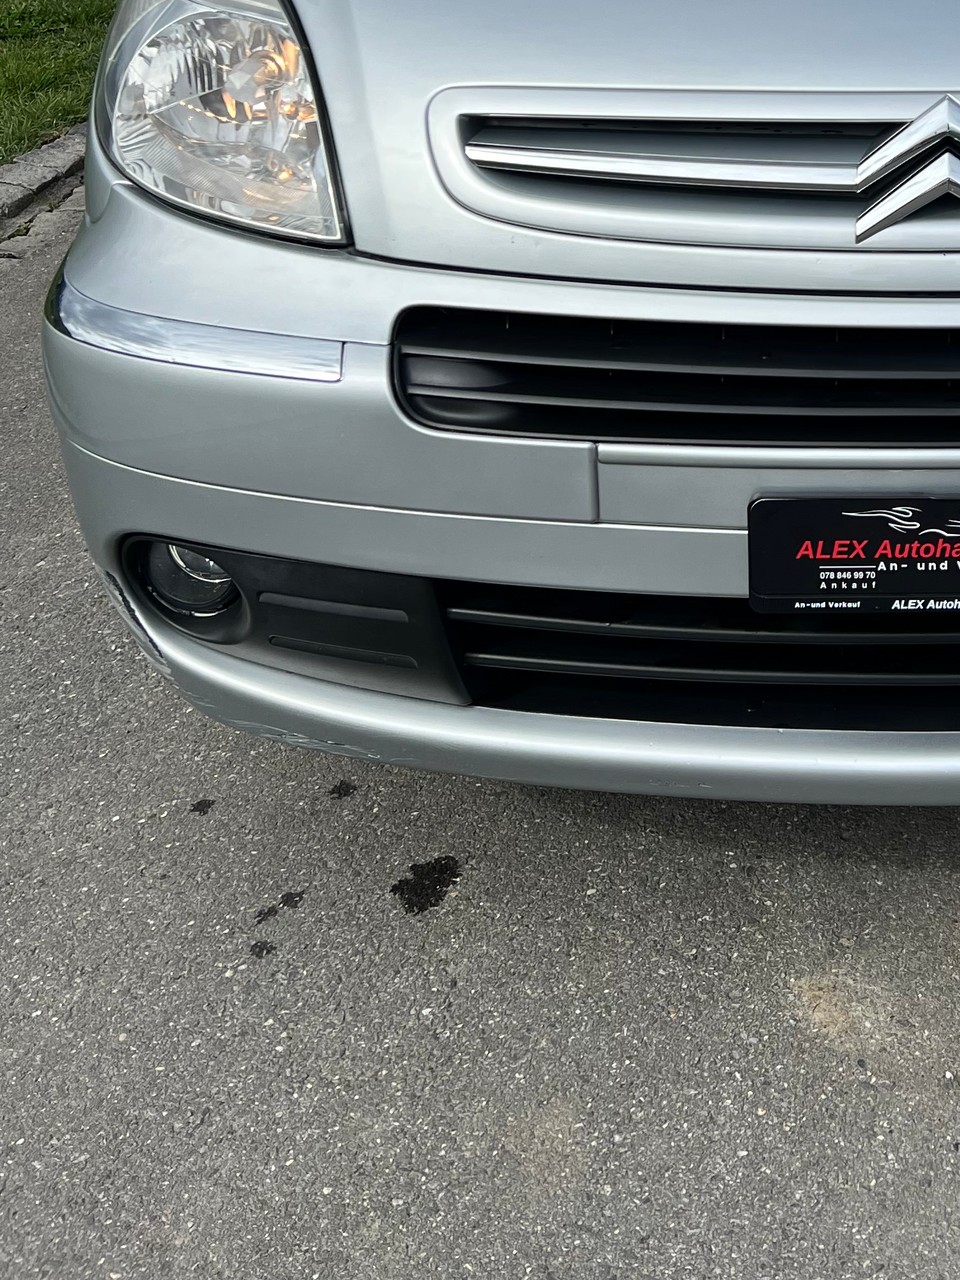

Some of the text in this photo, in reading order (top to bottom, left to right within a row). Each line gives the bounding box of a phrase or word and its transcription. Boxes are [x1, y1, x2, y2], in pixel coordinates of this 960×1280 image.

[796, 540, 868, 559] ALEX
[878, 561, 908, 570] An-
[917, 560, 948, 570] und
[820, 572, 835, 580] 078
[836, 572, 852, 580] 846
[854, 572, 864, 580] 99
[820, 581, 876, 590] Ankauf
[891, 600, 924, 610] ALEX
